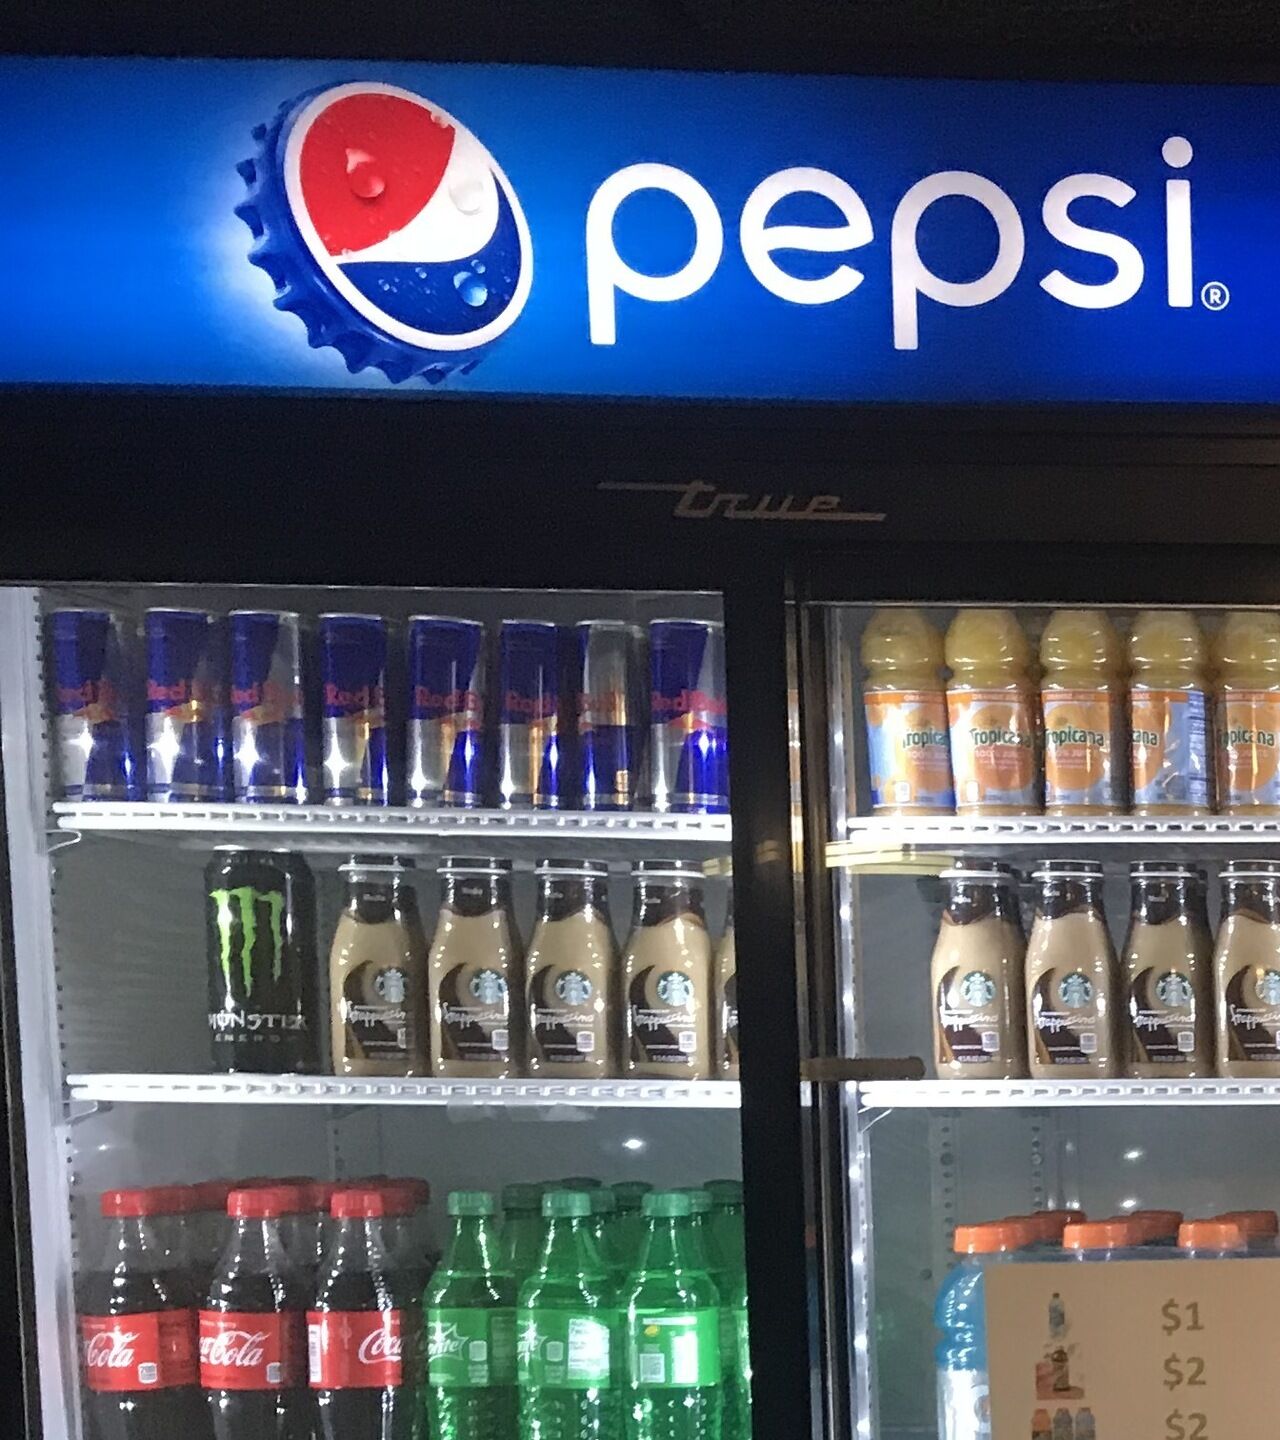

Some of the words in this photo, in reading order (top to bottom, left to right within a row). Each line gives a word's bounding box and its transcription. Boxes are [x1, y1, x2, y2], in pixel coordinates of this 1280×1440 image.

[586, 136, 1194, 350] pepsi
[1160, 1298, 1205, 1336] $1
[1163, 1352, 1207, 1391] $2
